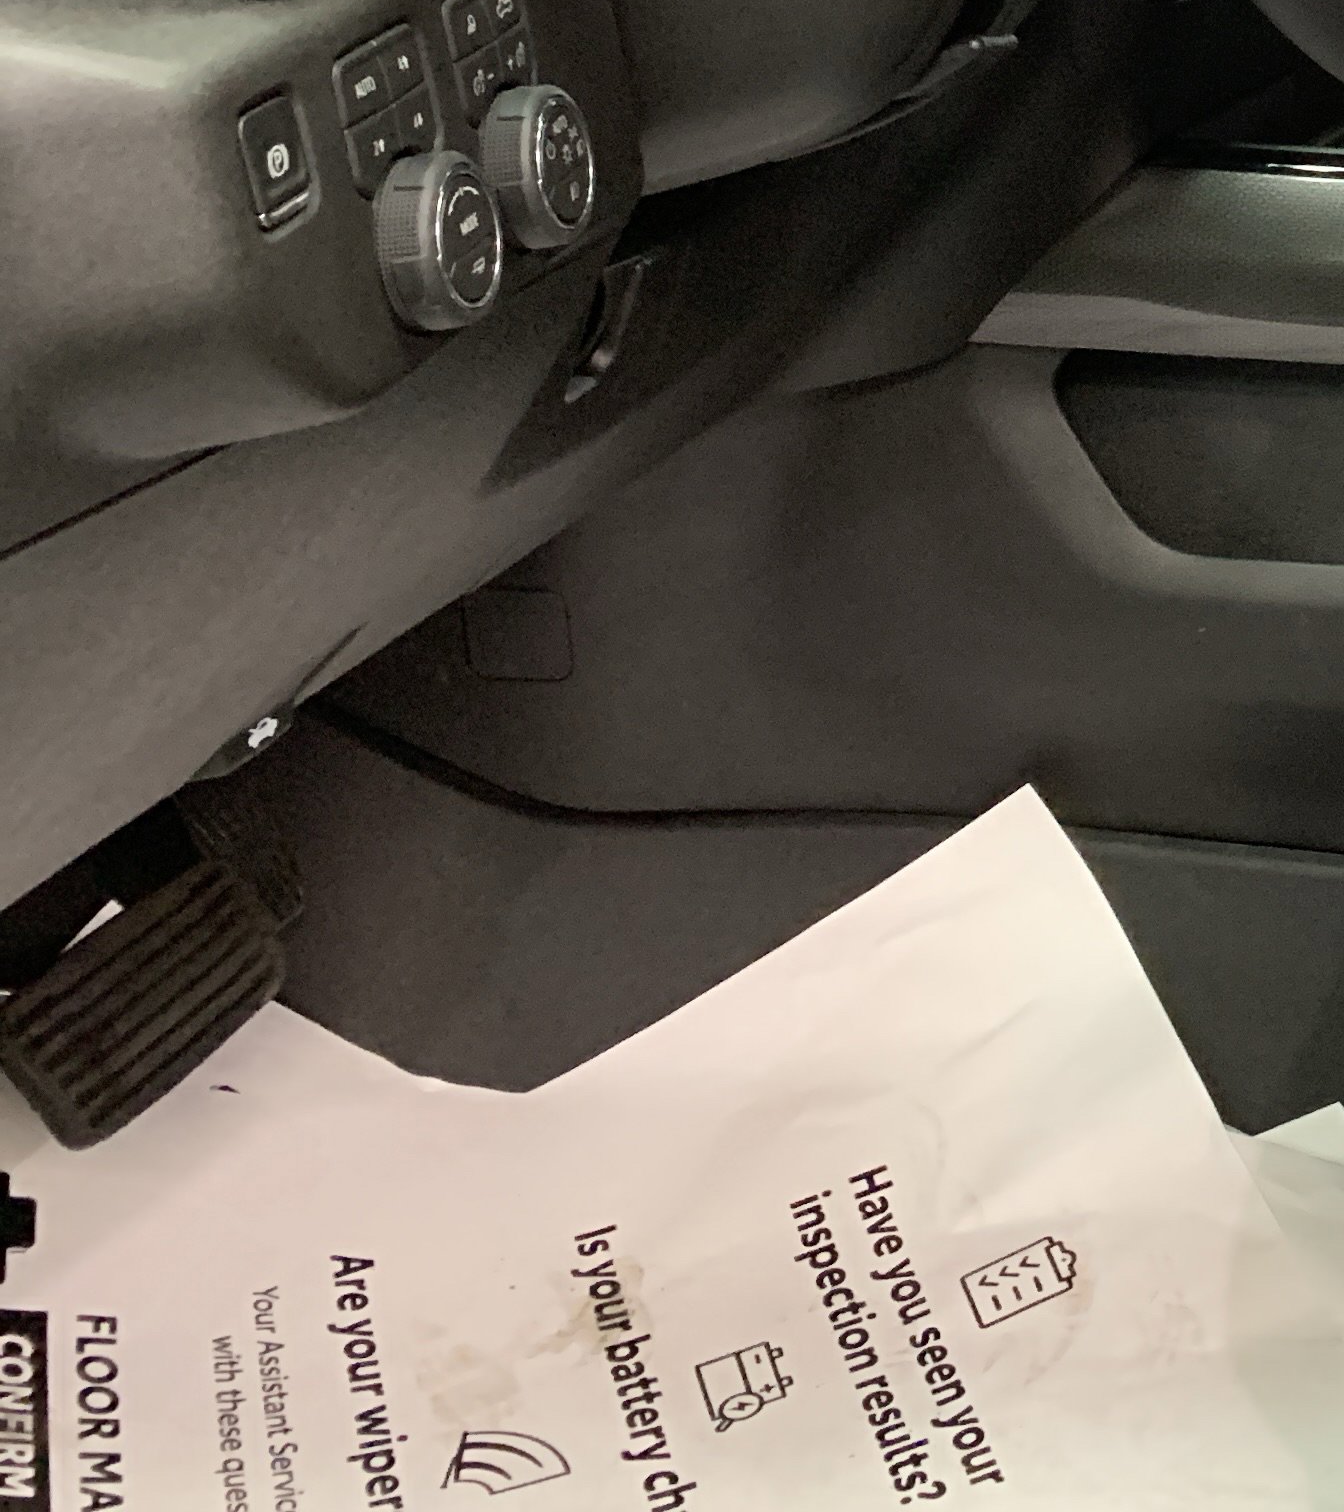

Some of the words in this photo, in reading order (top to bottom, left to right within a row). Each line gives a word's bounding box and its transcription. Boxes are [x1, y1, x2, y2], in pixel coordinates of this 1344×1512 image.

[574, 1225, 617, 1257] Is
[849, 1165, 904, 1257] Have
[252, 1285, 280, 1334] Your
[330, 1254, 374, 1312] Are
[571, 1259, 633, 1334] your
[870, 1259, 931, 1324] you
[76, 1315, 122, 1441] FLOOR
[211, 1335, 245, 1383] with
[327, 1318, 386, 1397] your
[790, 1190, 880, 1374] inspection
[855, 1376, 947, 1505] results?
[909, 1326, 966, 1407] seen
[0, 1333, 36, 1500] CONFIRM
[214, 1387, 247, 1452] these
[255, 1339, 294, 1439] Assistant
[603, 1334, 671, 1461] battery
[347, 1403, 408, 1510] wiper
[931, 1406, 1004, 1487] your
[643, 1470, 697, 1512] ch
